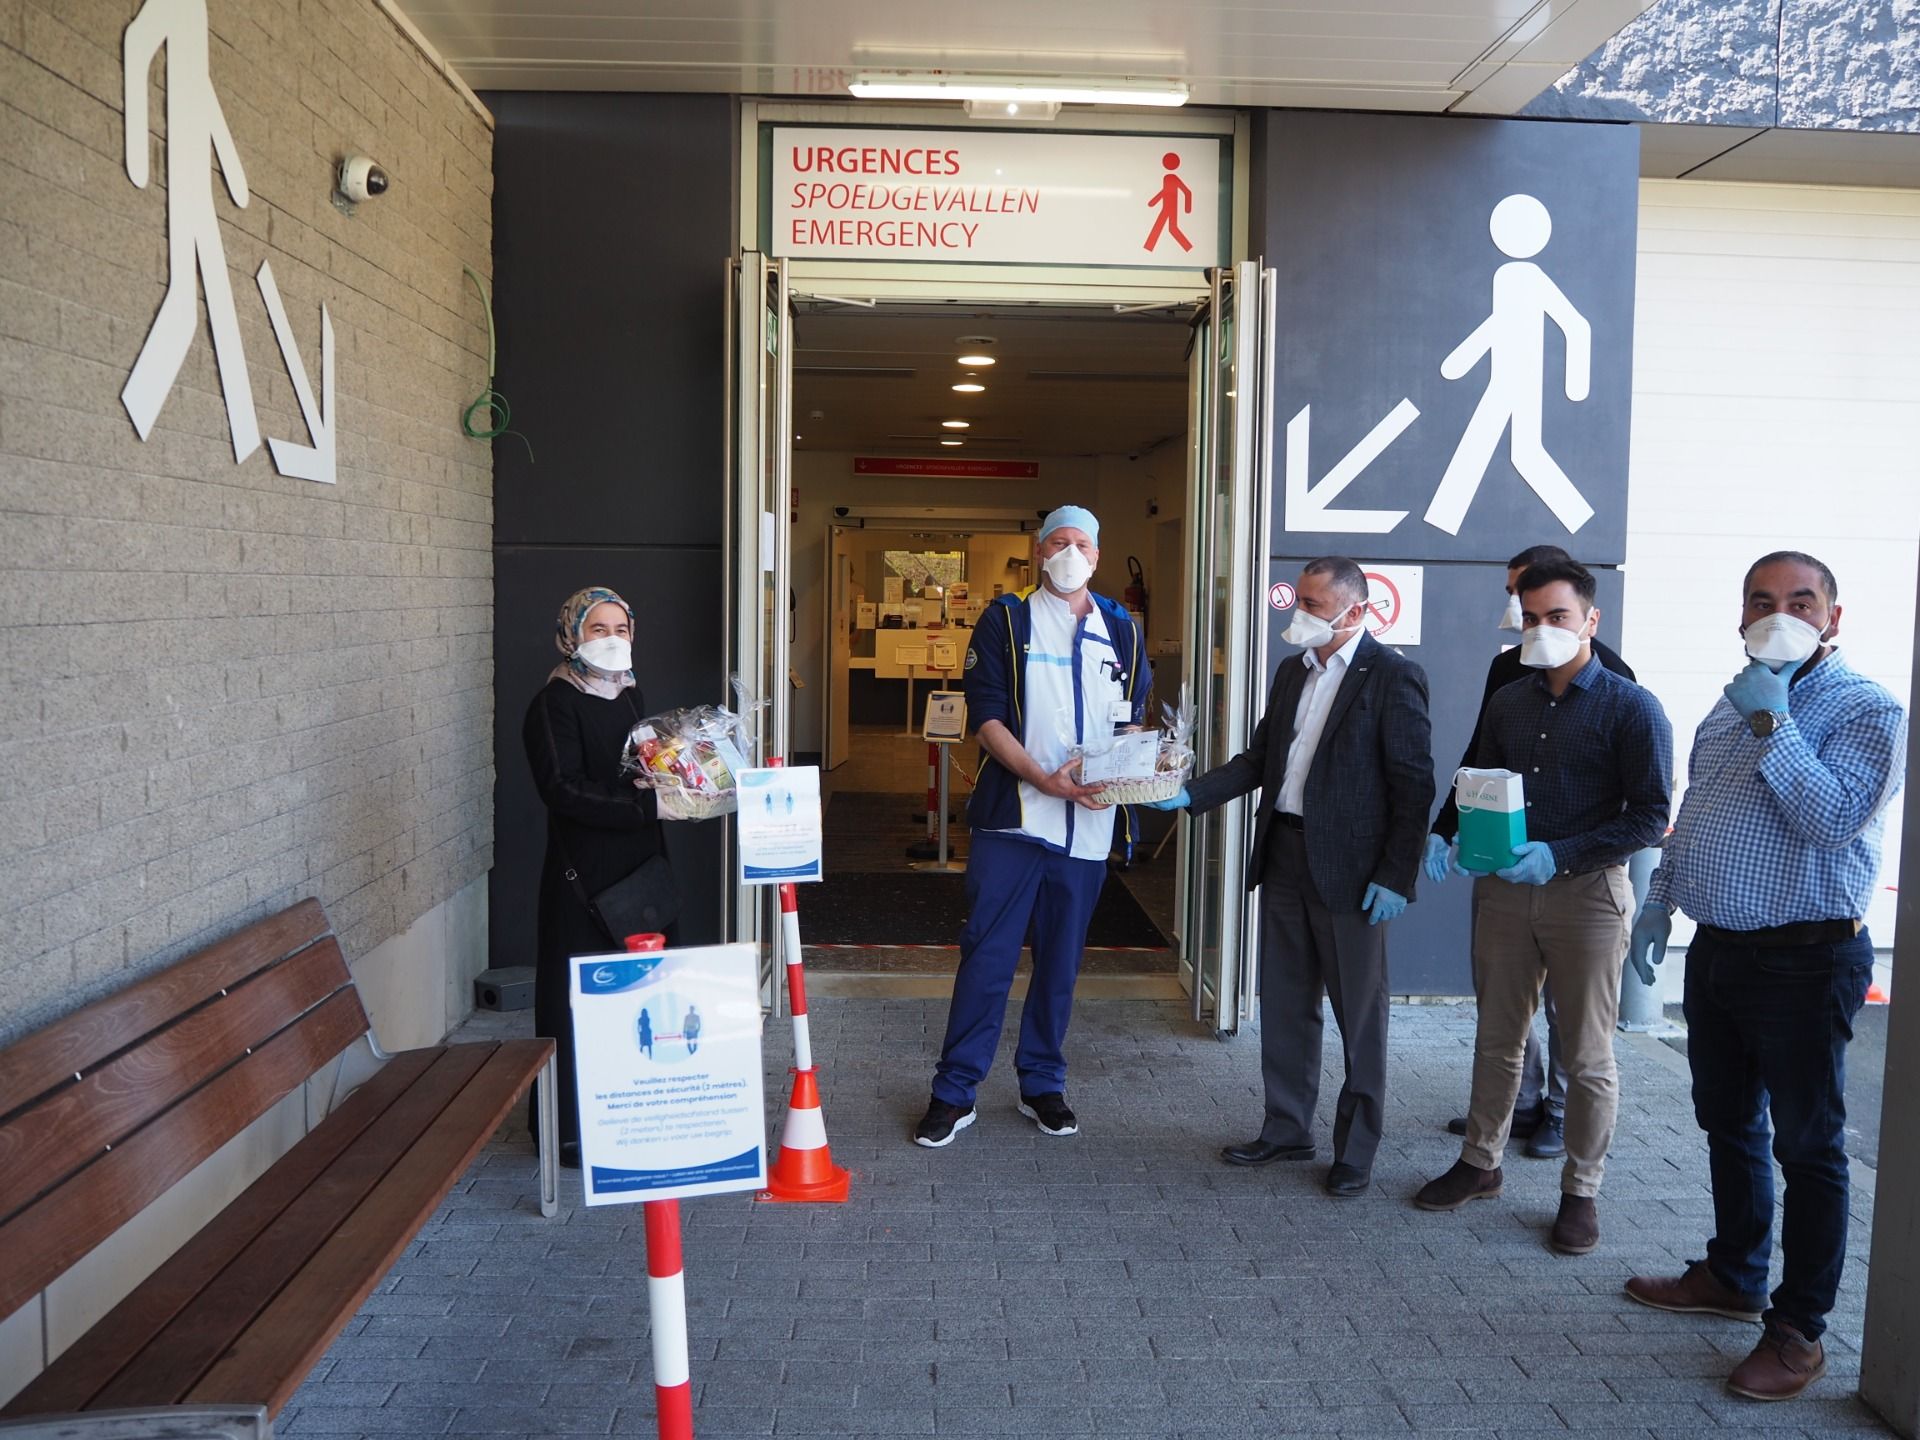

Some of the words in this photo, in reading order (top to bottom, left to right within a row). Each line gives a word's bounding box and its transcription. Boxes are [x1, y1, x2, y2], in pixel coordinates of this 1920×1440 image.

[793, 146, 960, 176] URGENCES
[791, 183, 1040, 214] SPOEDGEVALLEN
[792, 219, 979, 249] EMERGENCY
[633, 1077, 666, 1086] Veuillez
[668, 1073, 709, 1084] respecter
[609, 1089, 651, 1099] distances
[653, 1087, 664, 1095] de
[666, 1084, 700, 1094] sécurité
[607, 1101, 632, 1110] Merci
[633, 1100, 644, 1108] de
[646, 1098, 668, 1107] votre
